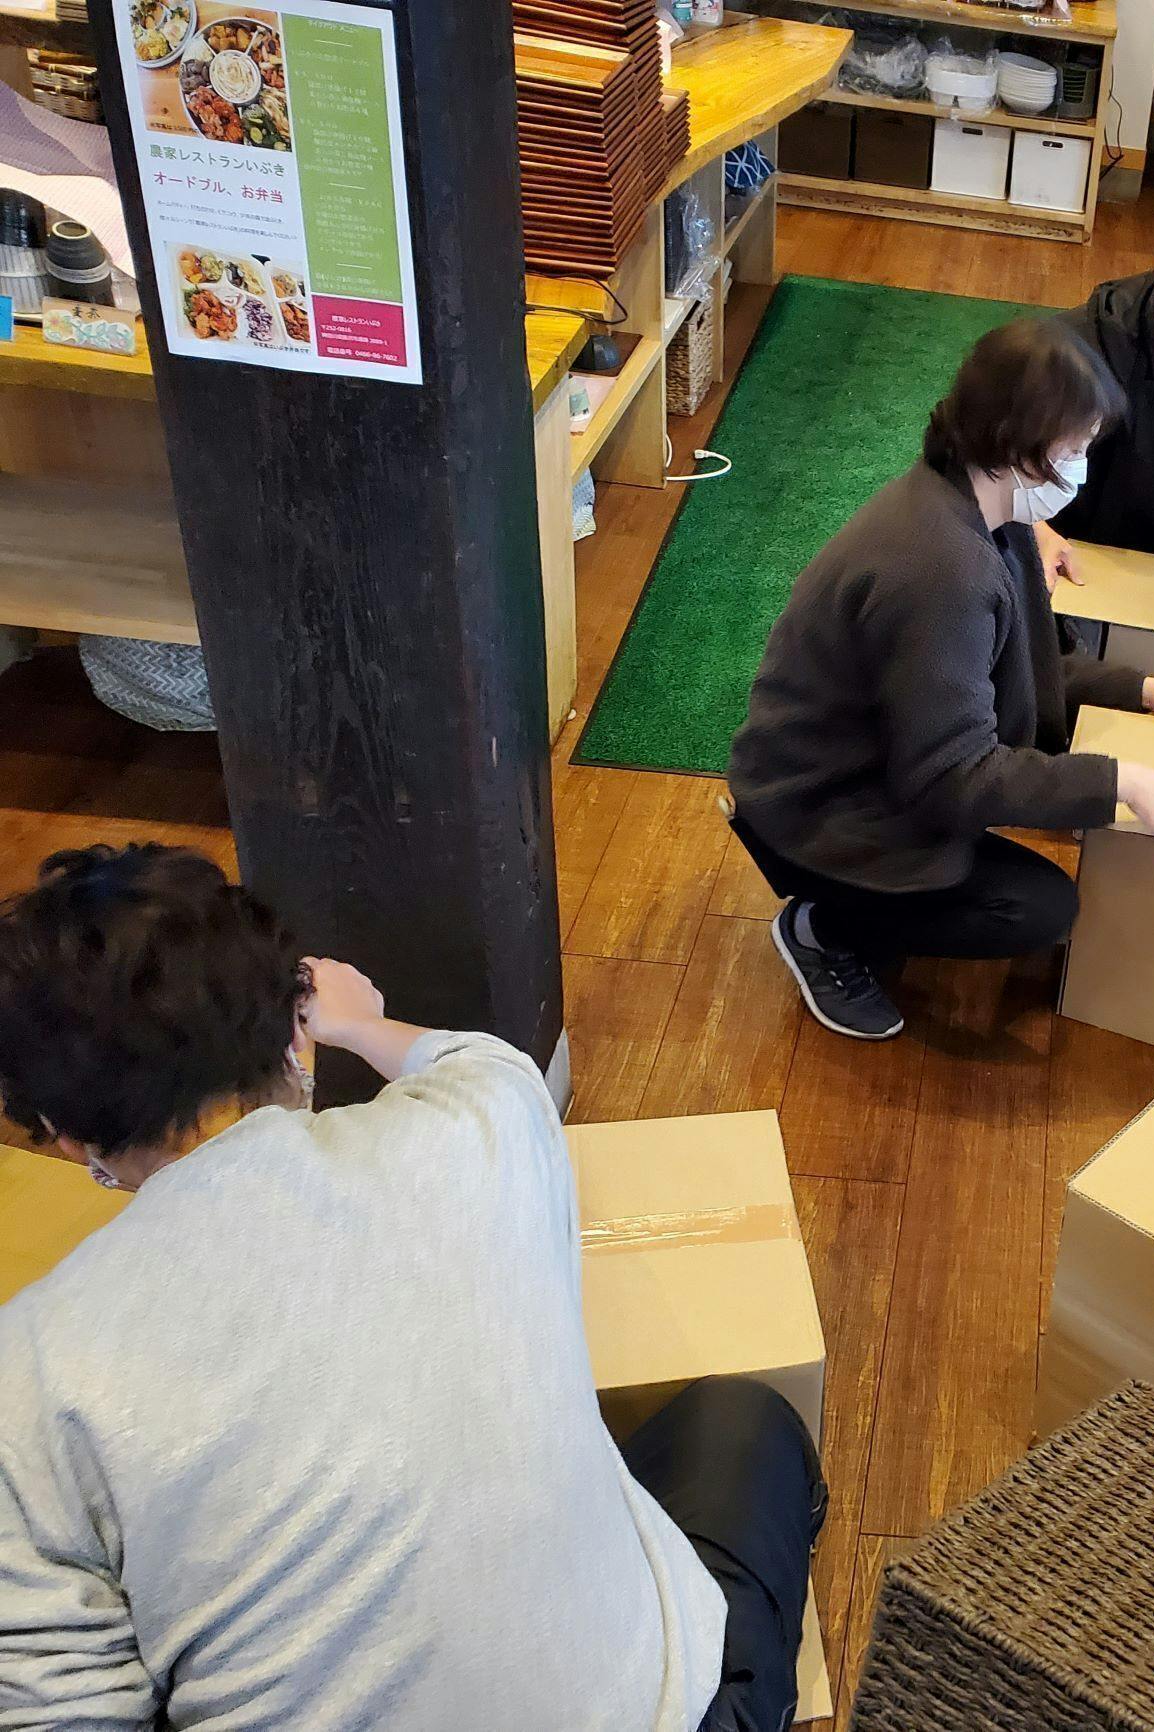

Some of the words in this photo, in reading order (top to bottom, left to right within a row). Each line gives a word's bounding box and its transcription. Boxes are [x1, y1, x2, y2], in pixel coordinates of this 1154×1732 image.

[150, 144, 285, 177] 農家レストランいぶき
[153, 171, 284, 204] オードブル、お弁当
